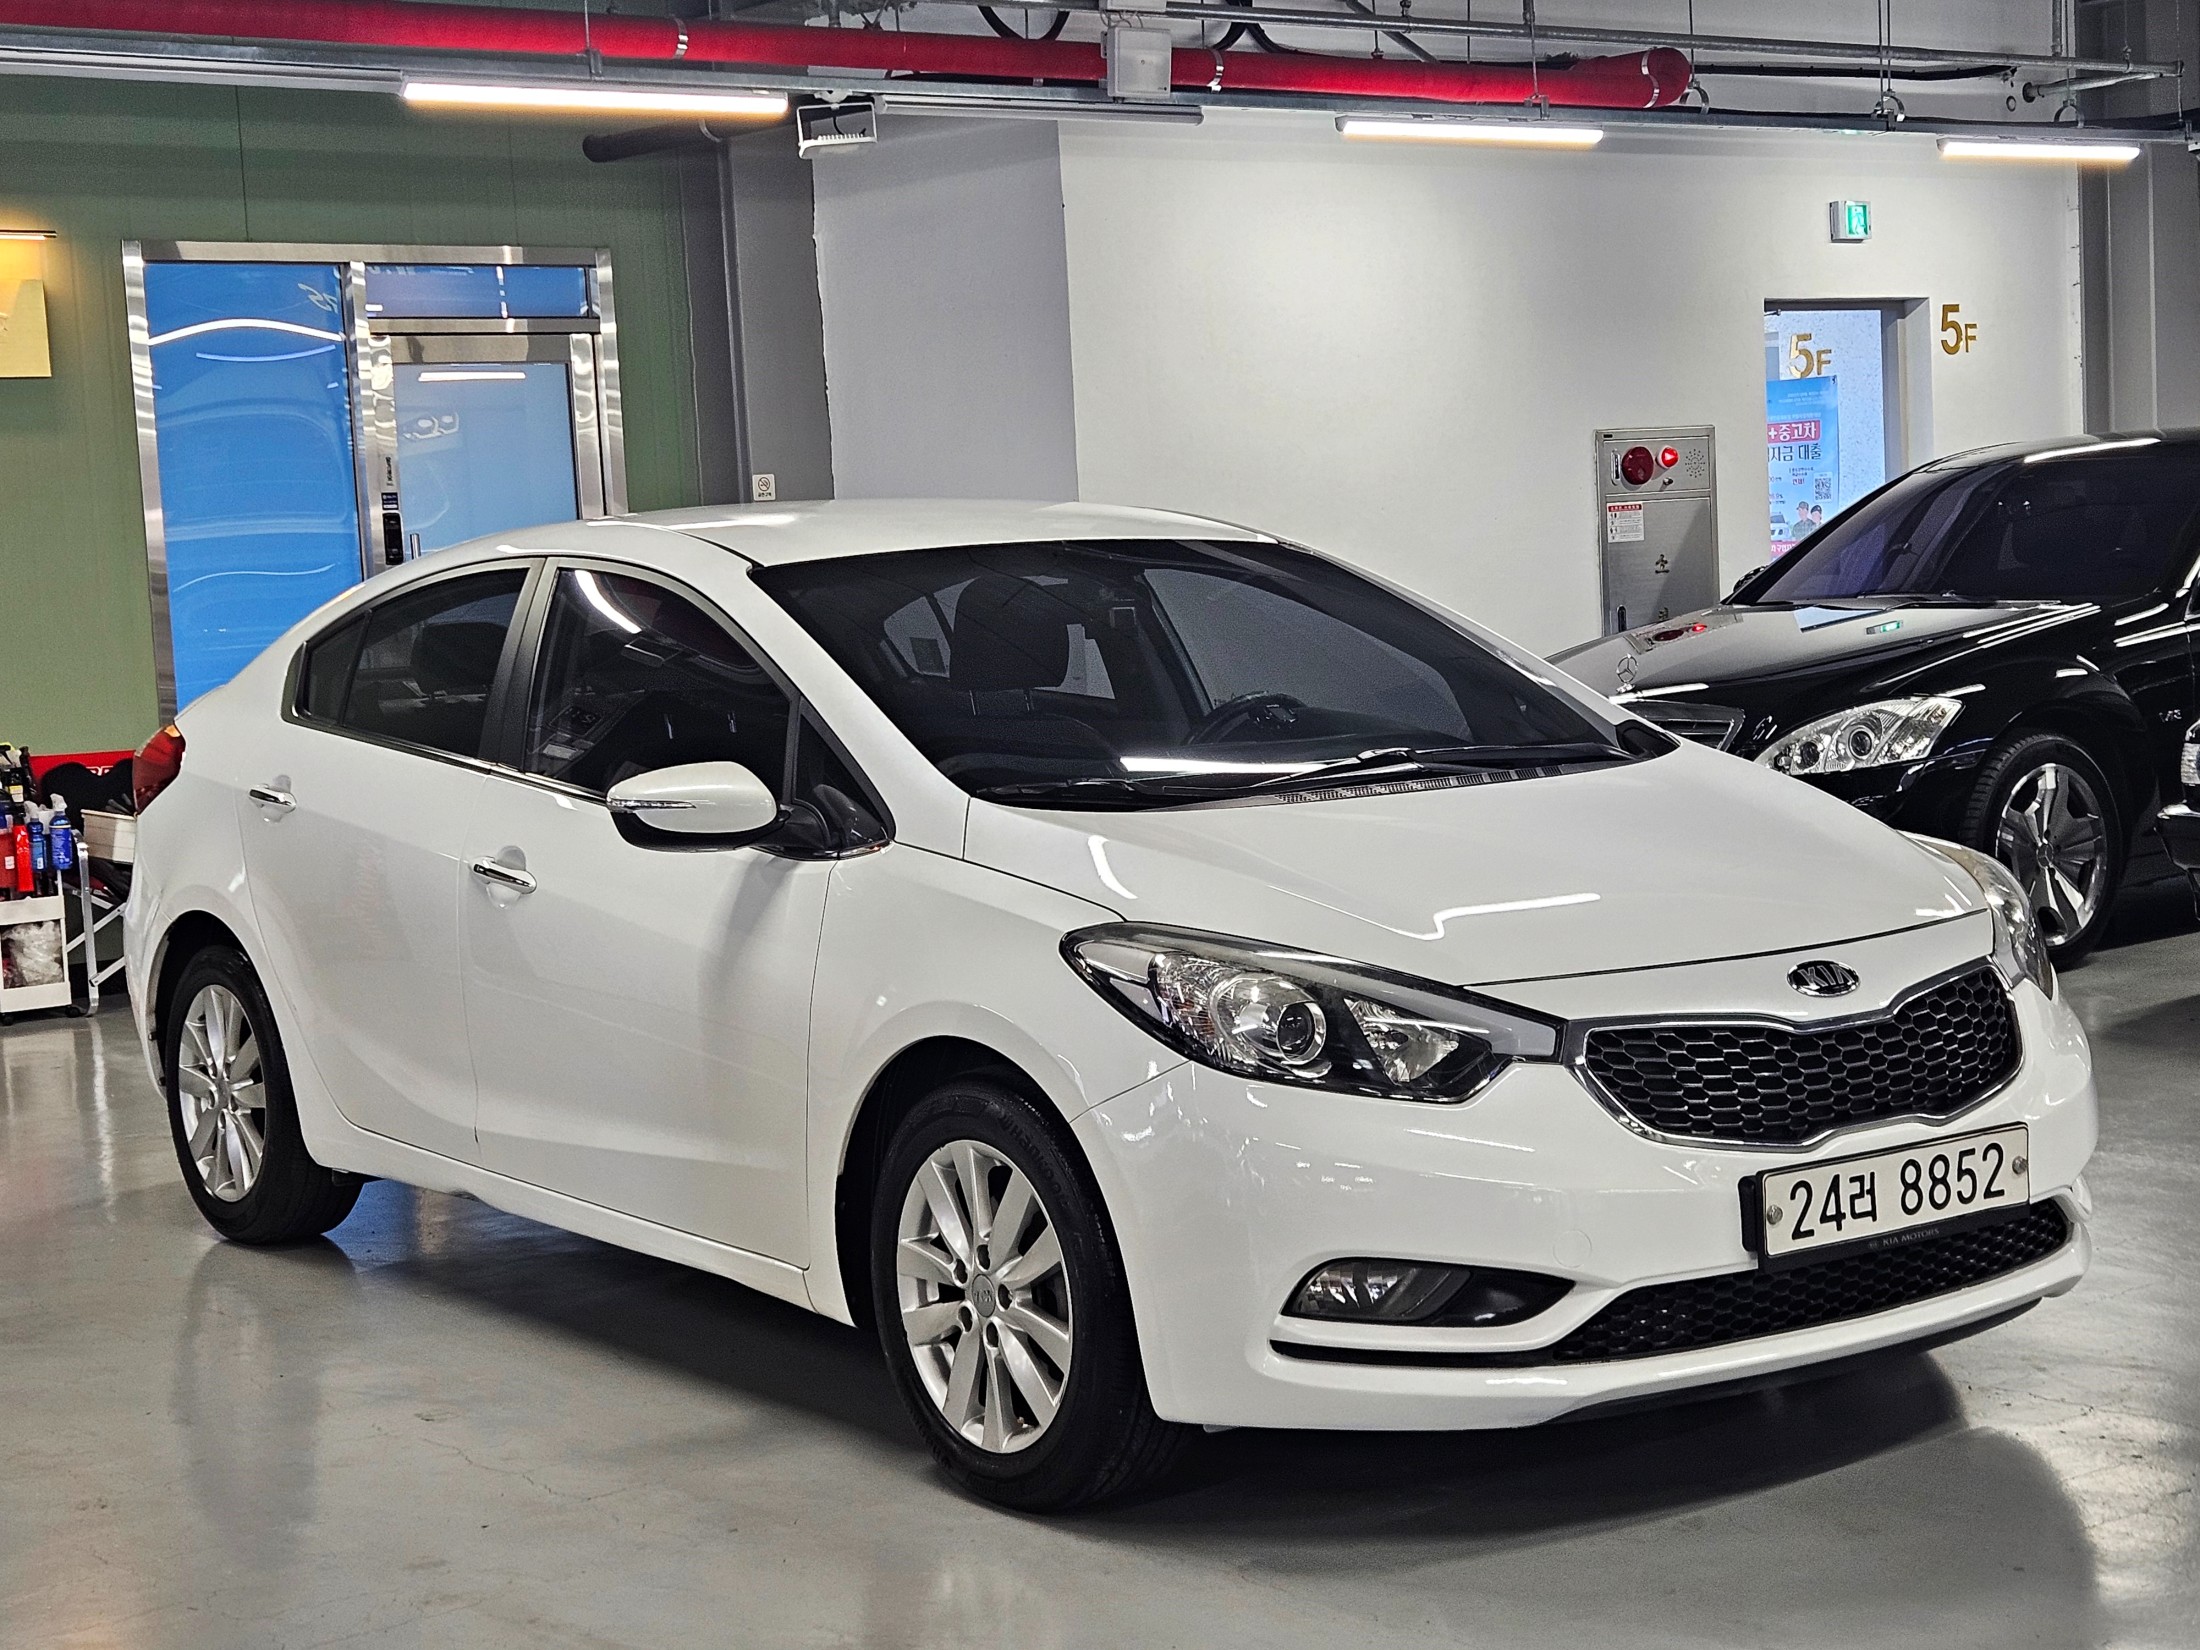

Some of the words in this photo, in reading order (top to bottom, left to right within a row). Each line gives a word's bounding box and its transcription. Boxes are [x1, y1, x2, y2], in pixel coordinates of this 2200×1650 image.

[1940, 304, 1978, 355] 5F
[1788, 333, 1832, 378] 5F
[1789, 1171, 1878, 1241] 24러
[1899, 1142, 2006, 1216] 8852
